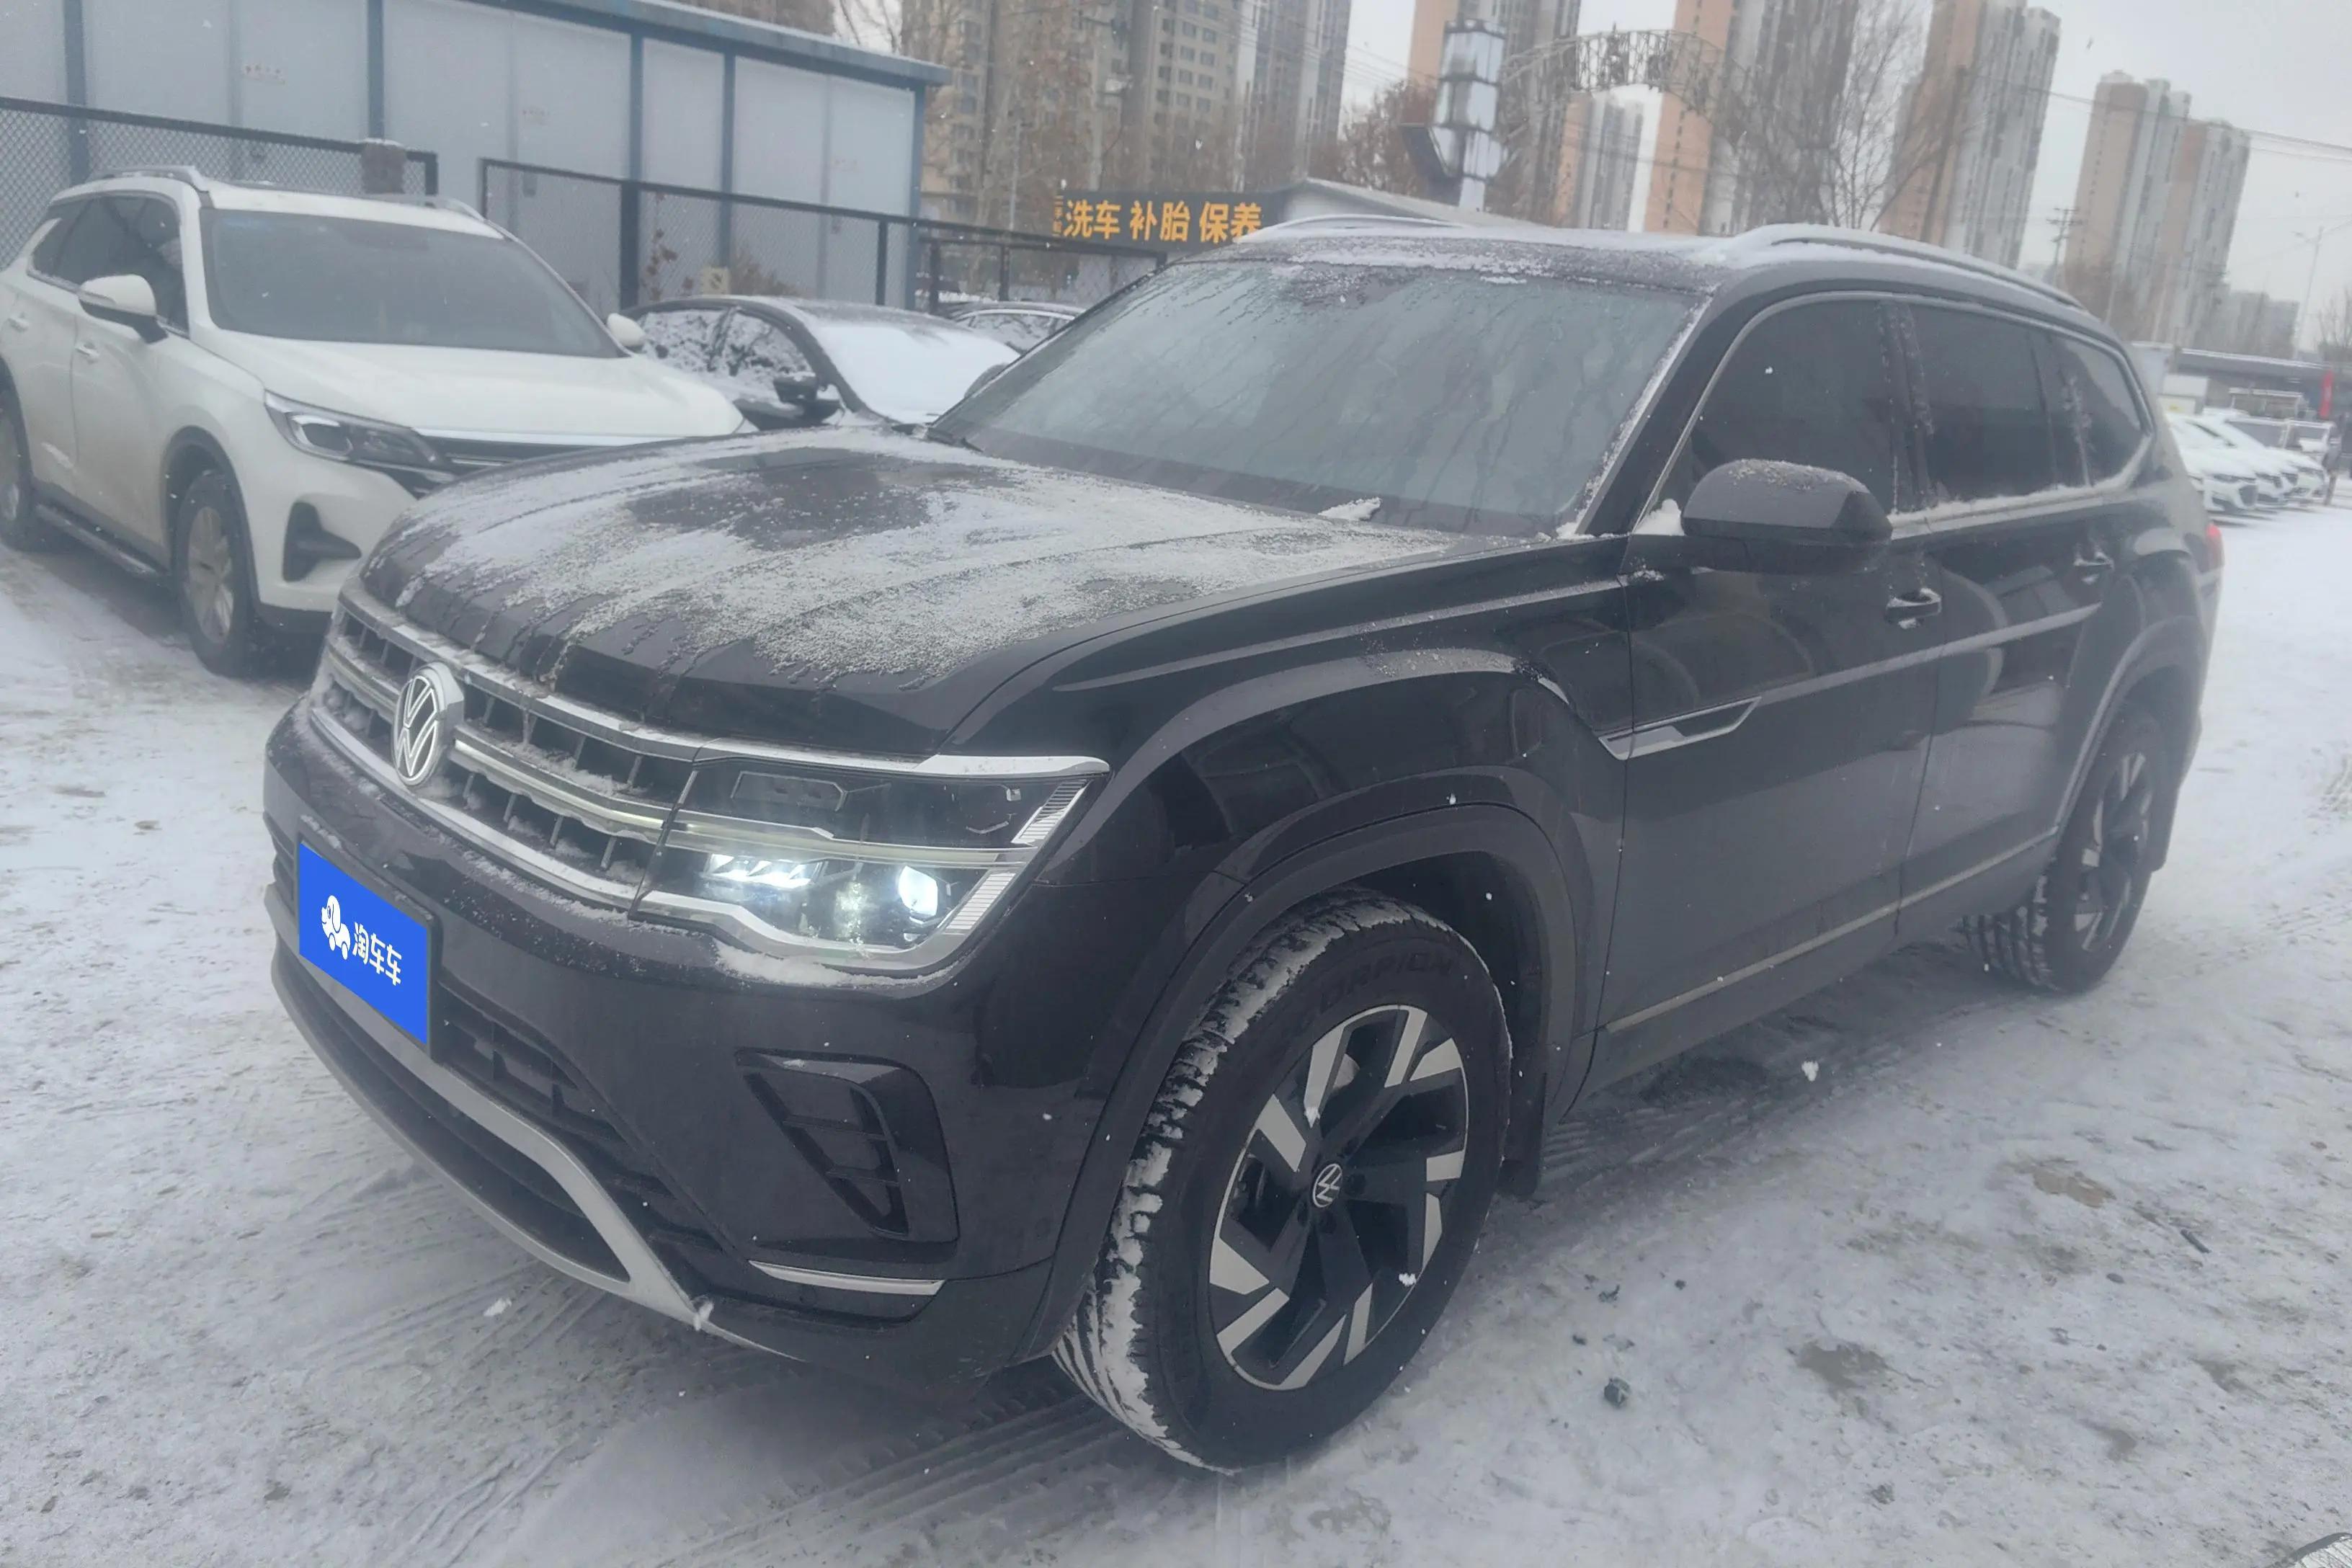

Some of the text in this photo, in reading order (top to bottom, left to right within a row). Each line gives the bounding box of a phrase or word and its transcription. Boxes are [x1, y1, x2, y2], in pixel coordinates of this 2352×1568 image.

[1063, 199, 1121, 239] 洗车
[1129, 200, 1191, 241] 补胎
[1198, 202, 1262, 244] 保养
